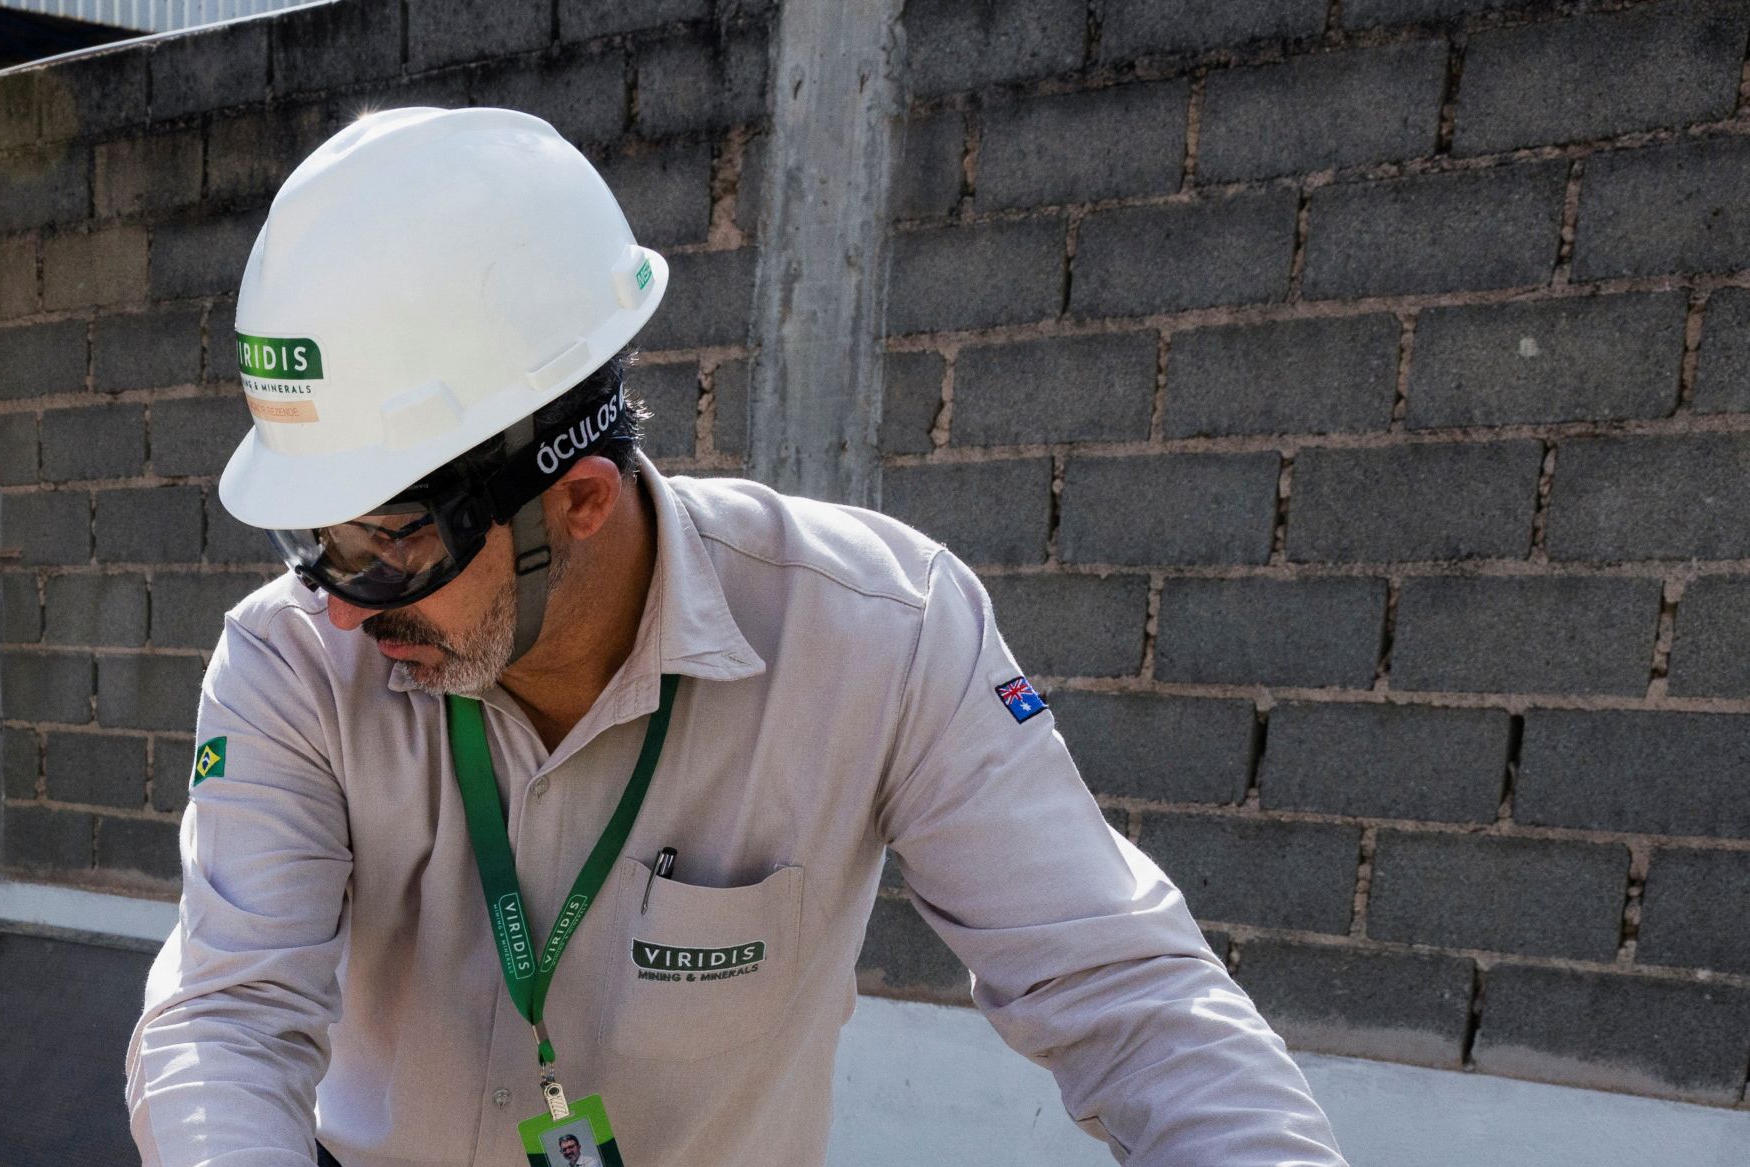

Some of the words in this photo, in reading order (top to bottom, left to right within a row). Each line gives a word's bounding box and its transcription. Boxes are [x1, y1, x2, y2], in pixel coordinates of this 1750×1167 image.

[237, 340, 309, 372] IRIDIS
[261, 384, 313, 394] MINERALS
[536, 394, 617, 474] ÓCULOS
[505, 902, 531, 970] VIRIDIS
[544, 901, 580, 964] VIRIDIS
[637, 970, 682, 982] MINING
[685, 973, 696, 982] &
[700, 964, 759, 981] MINERALS
[644, 946, 756, 968] VIRIDIS
